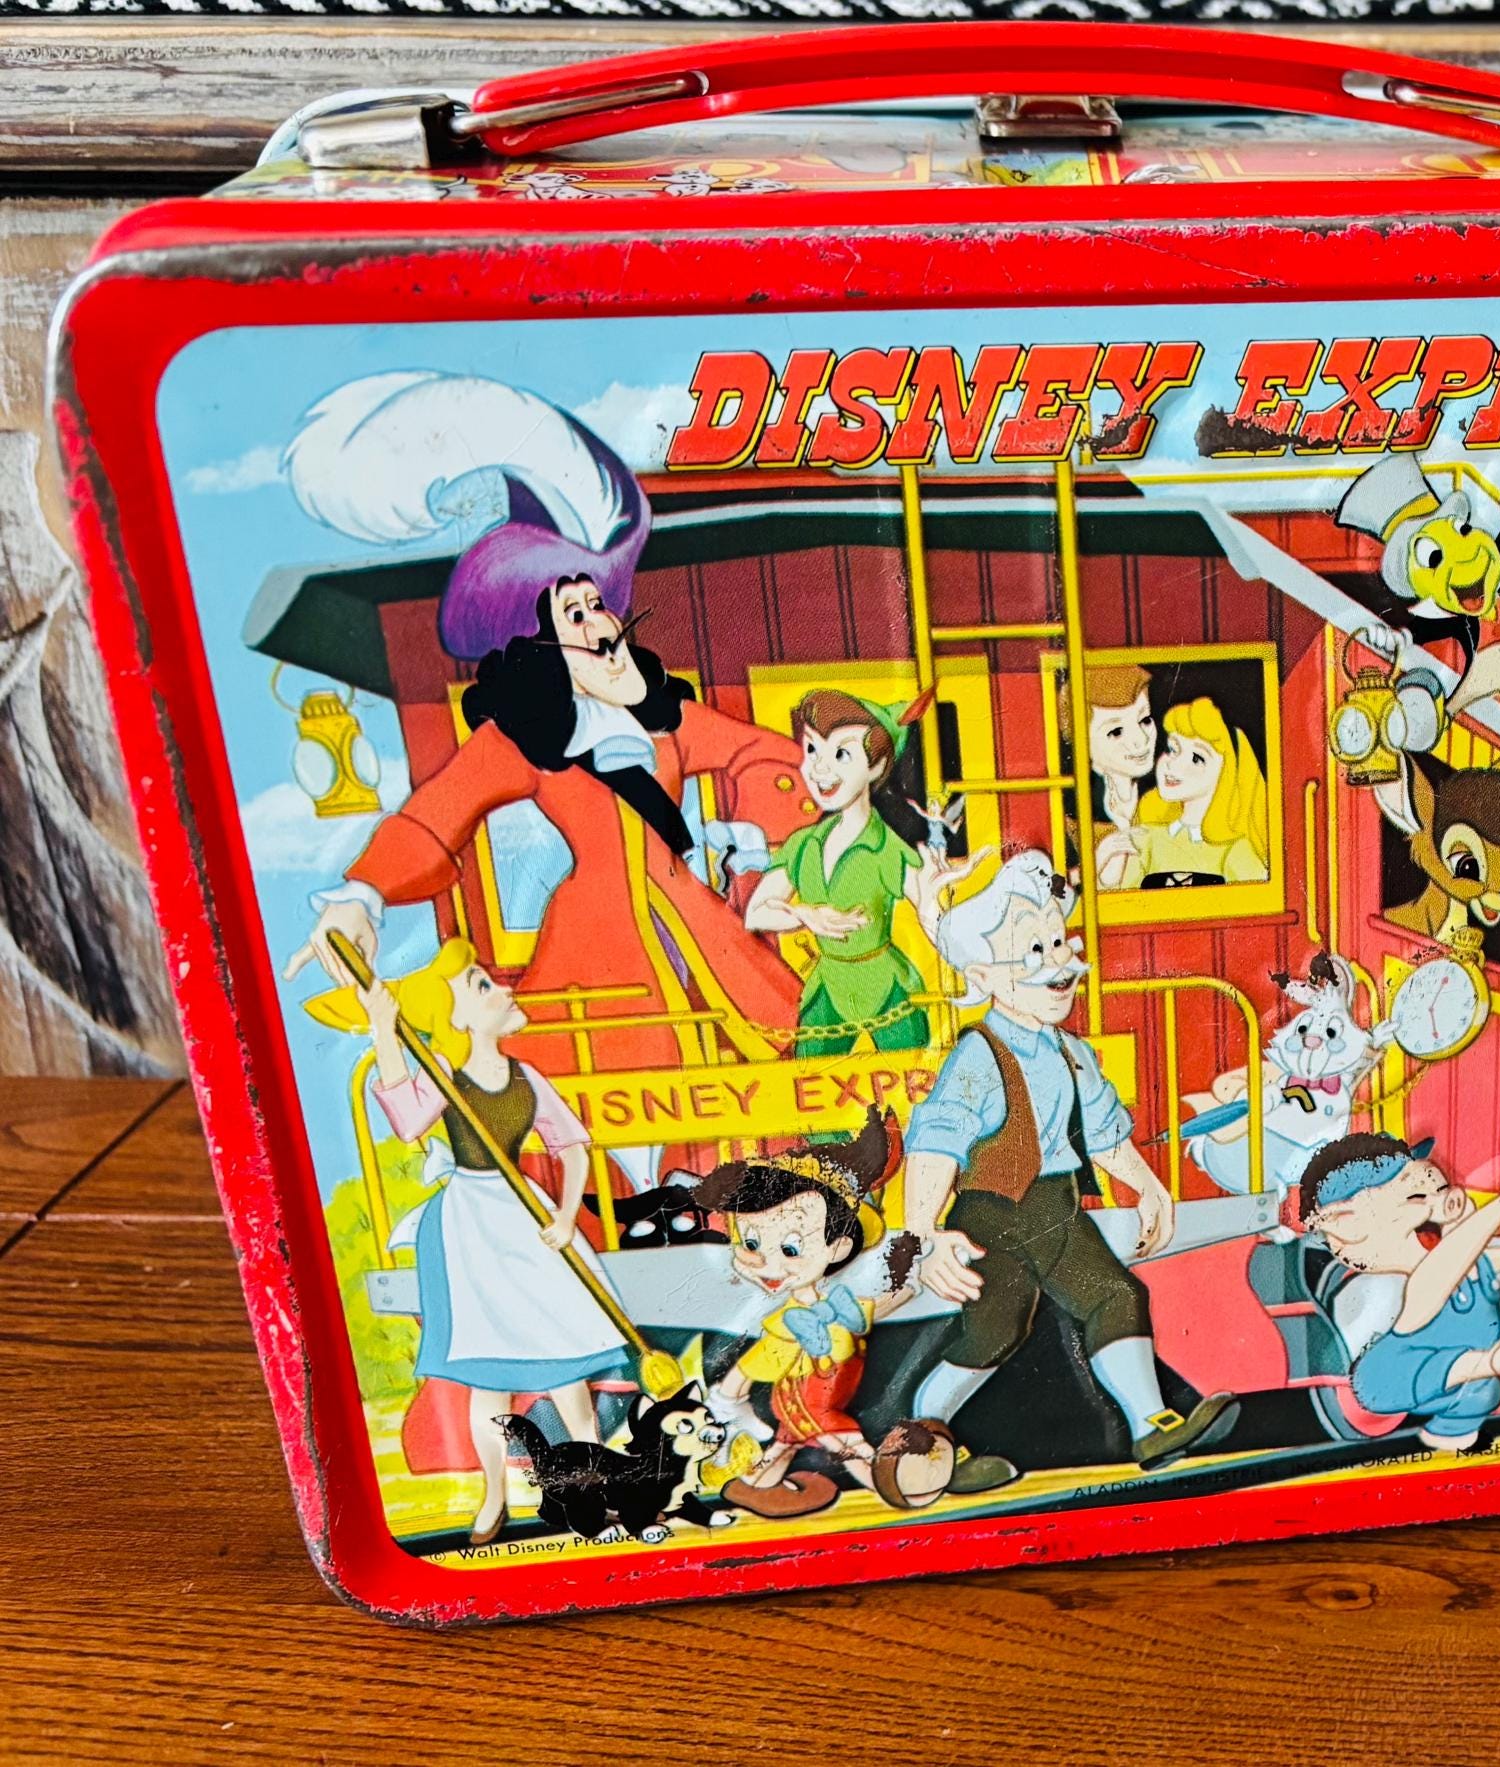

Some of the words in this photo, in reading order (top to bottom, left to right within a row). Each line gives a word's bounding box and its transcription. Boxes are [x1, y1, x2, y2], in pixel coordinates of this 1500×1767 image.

[665, 342, 1203, 472] DISNEY
[561, 1080, 760, 1128] ISNEY
[457, 1545, 501, 1561] Walt
[508, 1540, 566, 1557] Disney
